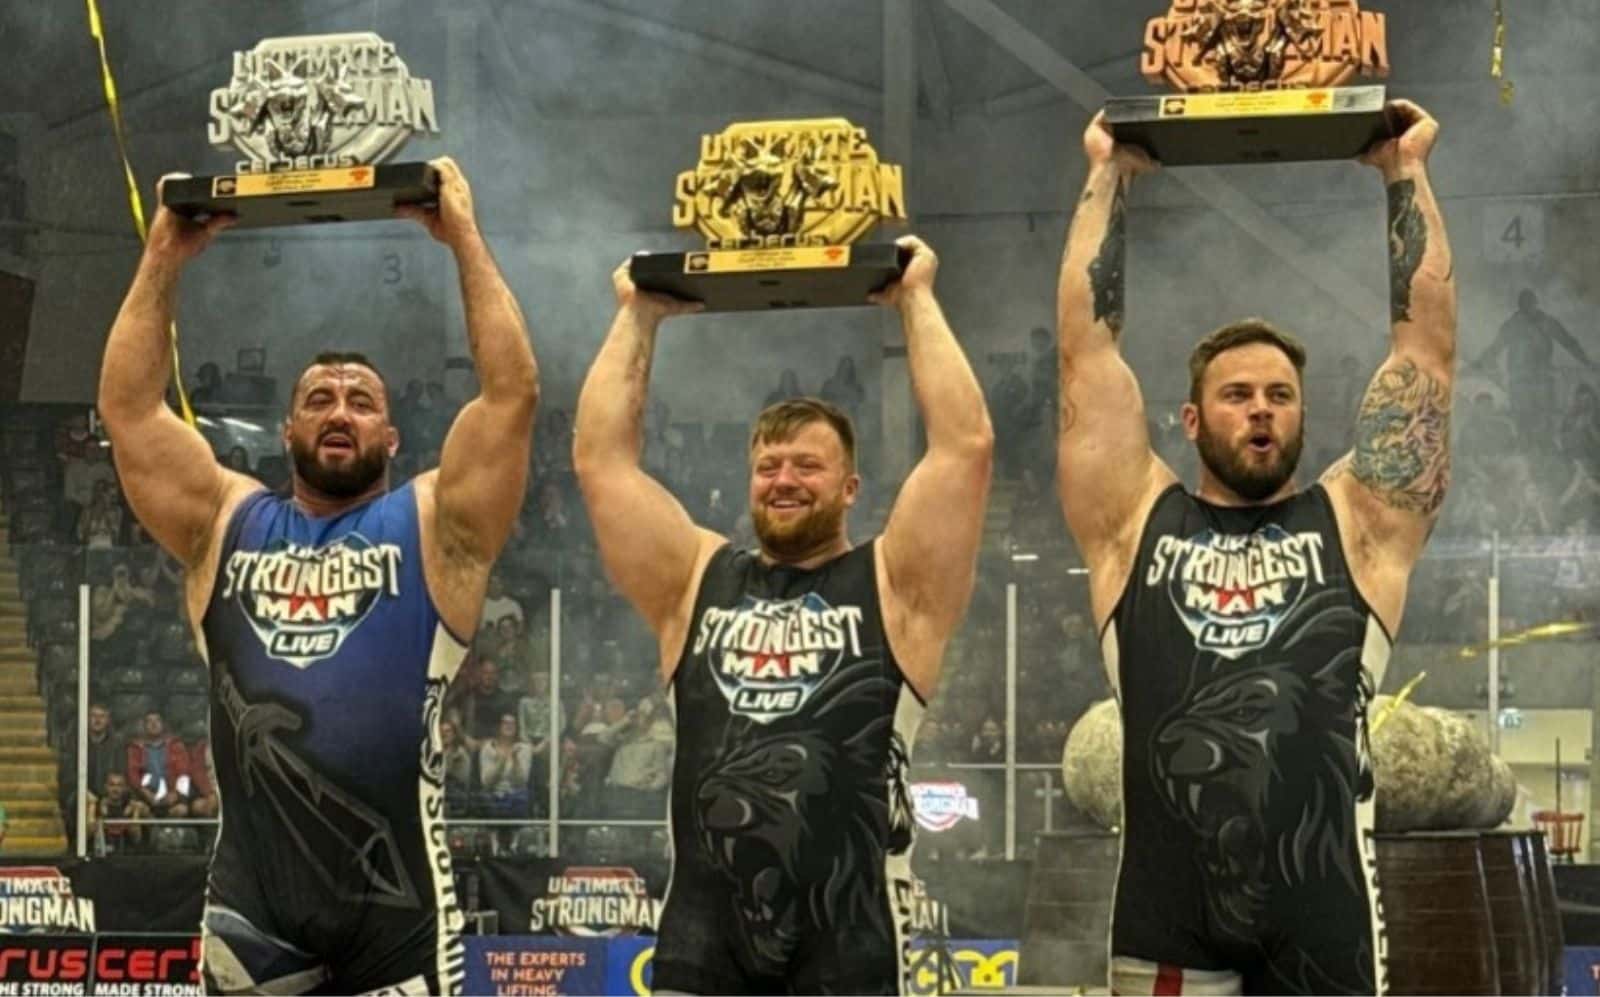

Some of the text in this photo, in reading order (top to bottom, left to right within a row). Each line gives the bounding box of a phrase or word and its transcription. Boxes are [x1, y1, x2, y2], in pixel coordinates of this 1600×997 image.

[1500, 215, 1526, 248] 4
[383, 254, 401, 284] 3
[223, 542, 402, 597] STRONGEST
[1146, 532, 1326, 587] STRONGEST
[256, 592, 356, 622] MAN
[1185, 582, 1286, 617] MAN
[693, 605, 863, 657] STRONGEST
[1204, 624, 1265, 646] LIVE
[275, 634, 333, 654] LIVE
[721, 651, 820, 679] MAN
[738, 691, 798, 711] LIVE
[547, 876, 646, 894] ULTIMATE
[486, 952, 586, 966] THE EXPERTS
[491, 968, 565, 982] IN HEAVY
[22, 983, 84, 996] STRONG
[95, 983, 139, 996] MADE
